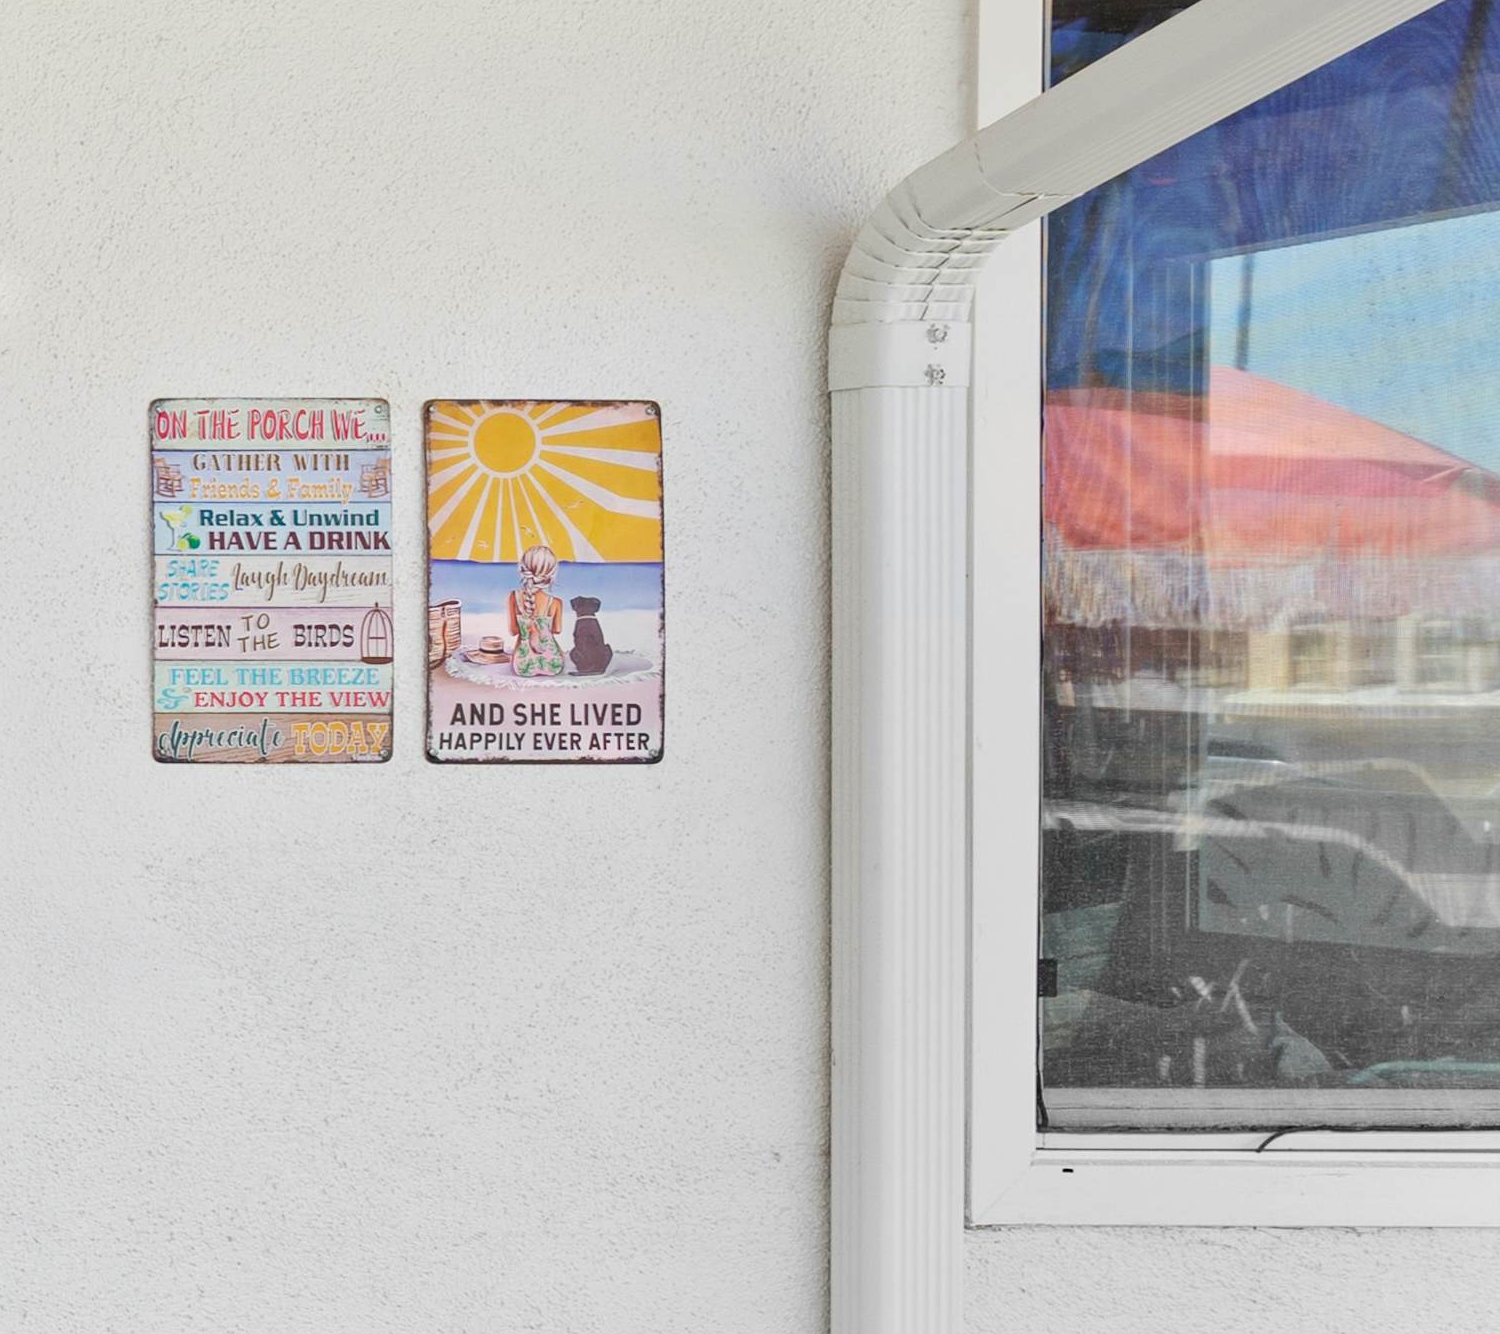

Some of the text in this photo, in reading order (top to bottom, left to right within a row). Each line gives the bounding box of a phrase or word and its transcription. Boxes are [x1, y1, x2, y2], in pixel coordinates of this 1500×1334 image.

[156, 408, 388, 442] ON THE PORCH WE...
[193, 453, 350, 471] GATHER WITH
[190, 477, 354, 505] Friends & Family
[199, 509, 379, 527] Relax & Unwind
[208, 531, 391, 551] HAVE A DRINK
[167, 559, 220, 578] SHARE
[232, 561, 389, 603] Laugh Daydream
[157, 583, 230, 602] STORIES
[158, 613, 355, 653] LISTEN TO THE BIRDS
[170, 668, 380, 686] FEEL THE BREEZE
[194, 691, 269, 708] ENJOY
[275, 691, 322, 708] THE
[329, 691, 390, 708] VIEW
[450, 703, 642, 726] AND SHE LIVED
[158, 718, 389, 758] Appreciate TODAY
[439, 732, 650, 750] HAPPILY EVER AFTER
